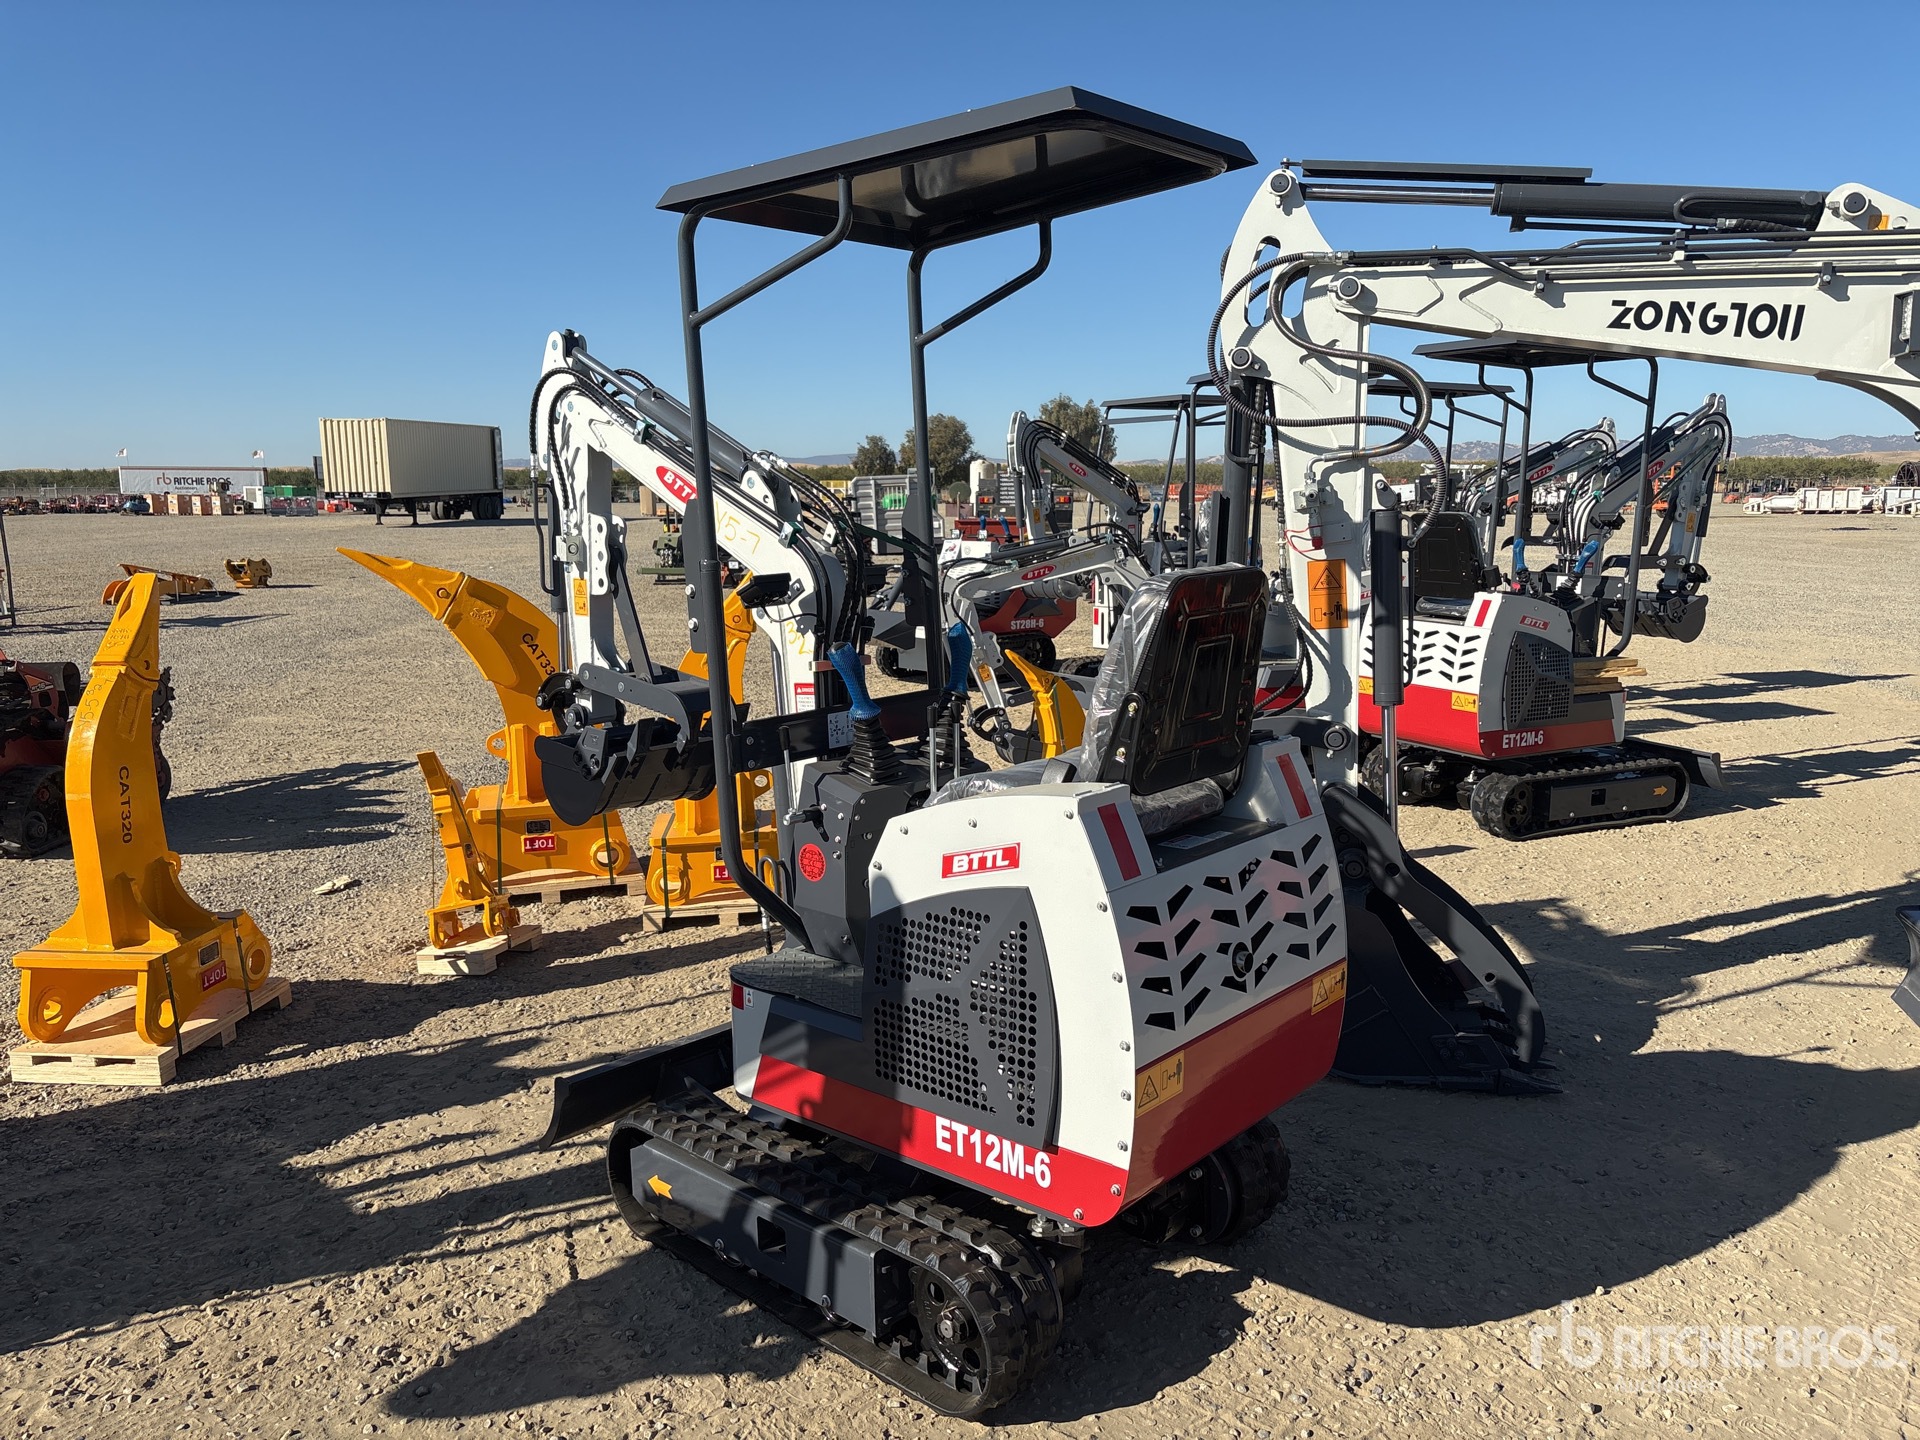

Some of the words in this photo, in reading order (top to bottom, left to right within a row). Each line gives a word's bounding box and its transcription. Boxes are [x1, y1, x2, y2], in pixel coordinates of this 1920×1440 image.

[174, 477, 205, 486] RITCHIE
[1027, 568, 1050, 579] BTTL
[1010, 618, 1045, 630] ST28H-6
[1524, 617, 1546, 628] BTTL
[521, 632, 556, 676] CAT33
[1502, 730, 1544, 749] ET12M-6
[118, 765, 133, 844] CAT320
[525, 838, 554, 850] TOFT
[952, 849, 1010, 873] BTTL
[714, 867, 729, 878] FT
[203, 966, 227, 988] TOFT
[935, 1114, 1052, 1189] ET12M-6
